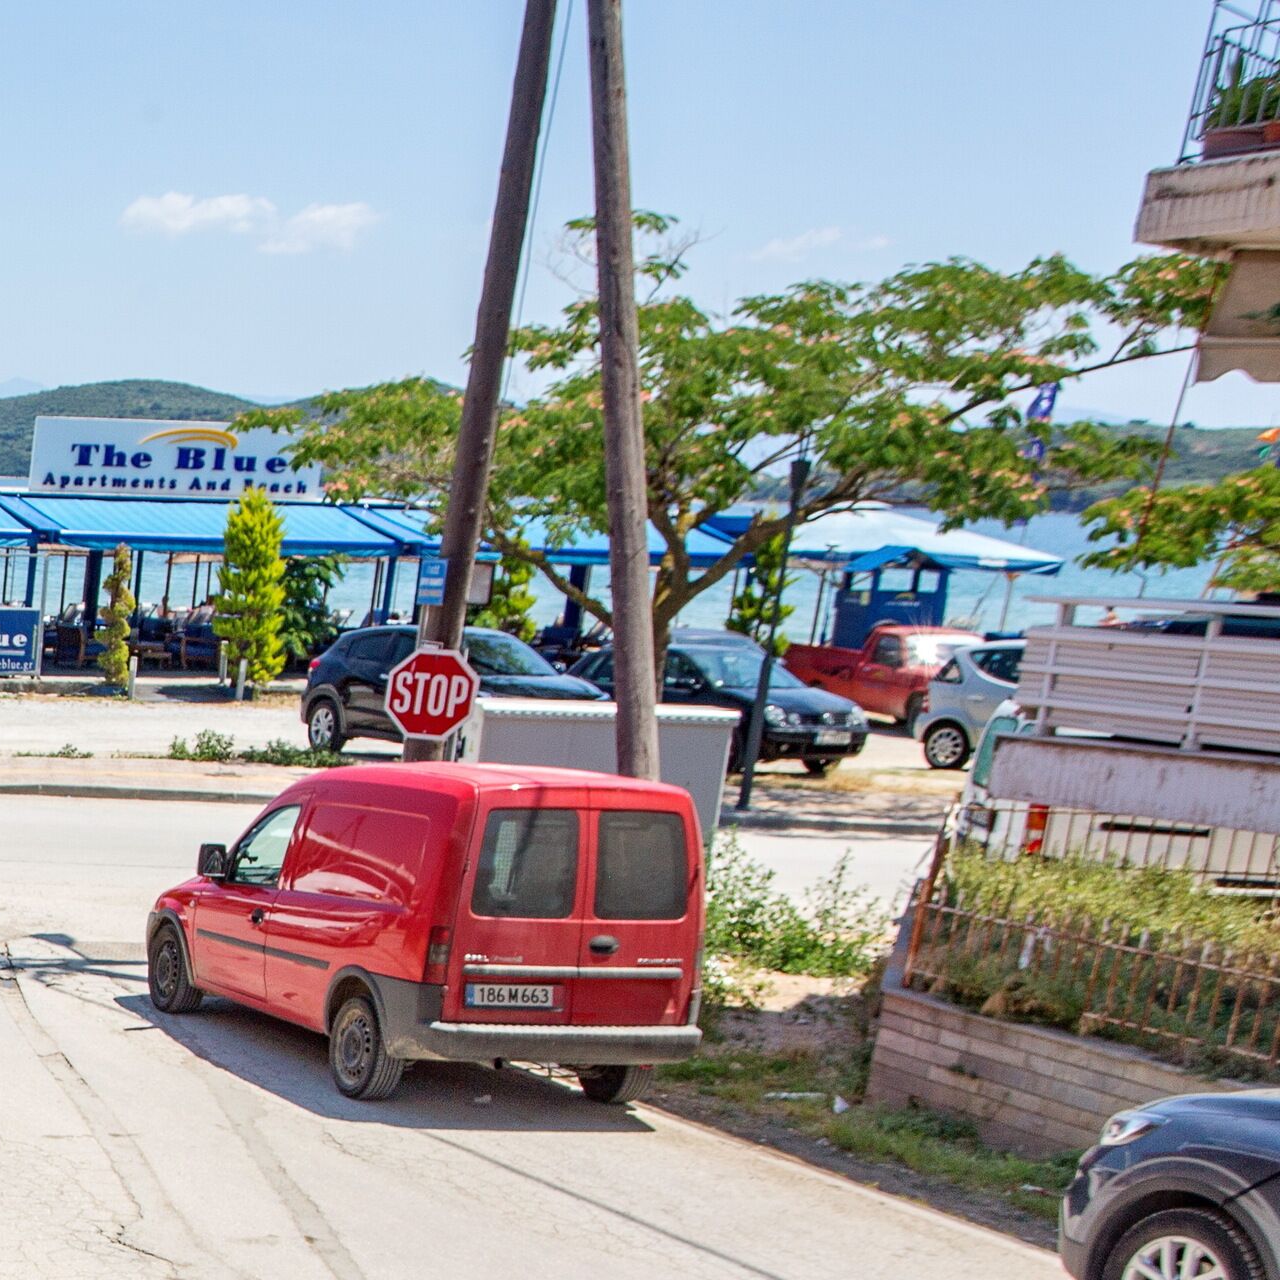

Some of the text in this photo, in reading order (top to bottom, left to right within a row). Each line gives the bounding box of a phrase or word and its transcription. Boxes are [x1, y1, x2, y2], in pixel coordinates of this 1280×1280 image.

[71, 443, 290, 474] The Blue
[42, 472, 178, 489] Apartments
[188, 476, 232, 491] And
[393, 670, 470, 718] STOP
